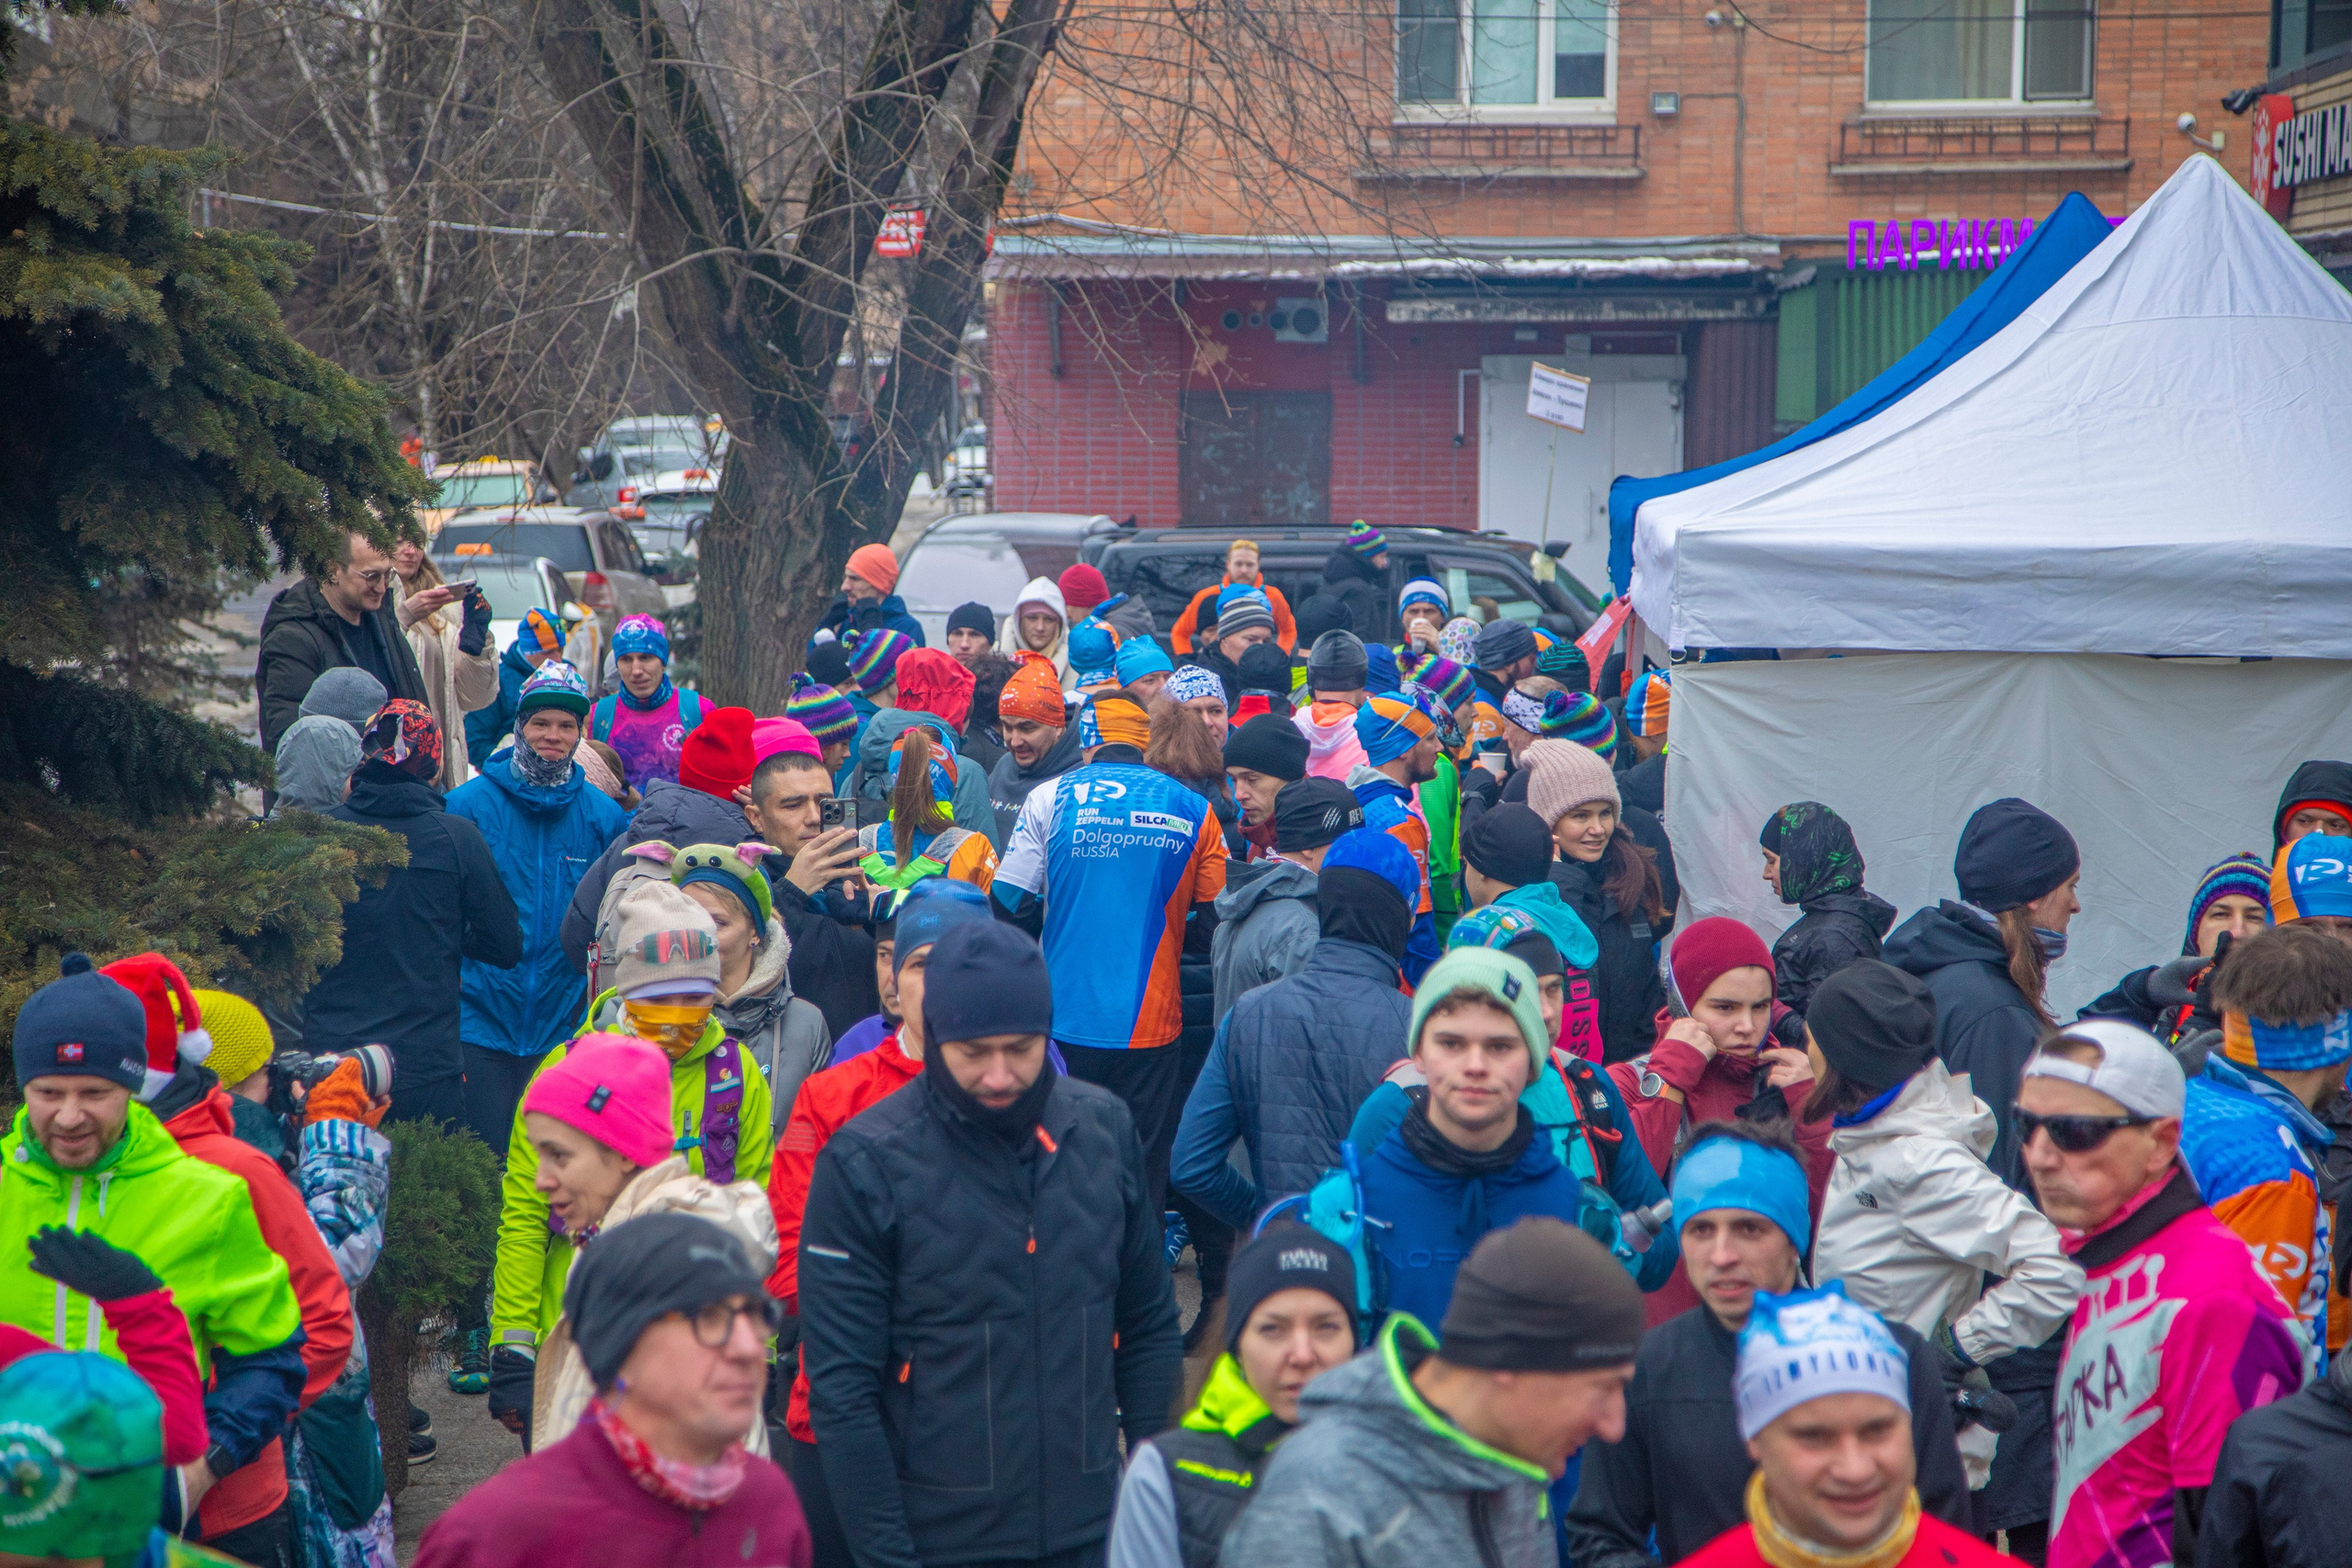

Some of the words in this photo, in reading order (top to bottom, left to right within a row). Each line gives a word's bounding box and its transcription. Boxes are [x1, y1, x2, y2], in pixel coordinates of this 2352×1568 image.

[2273, 110, 2321, 189] SUSHI
[1077, 807, 1100, 818] RUN
[1075, 816, 1125, 827] ZEPPELIN
[1072, 828, 1185, 854] Dolgoprudny
[1071, 846, 1119, 859] RUSSIA
